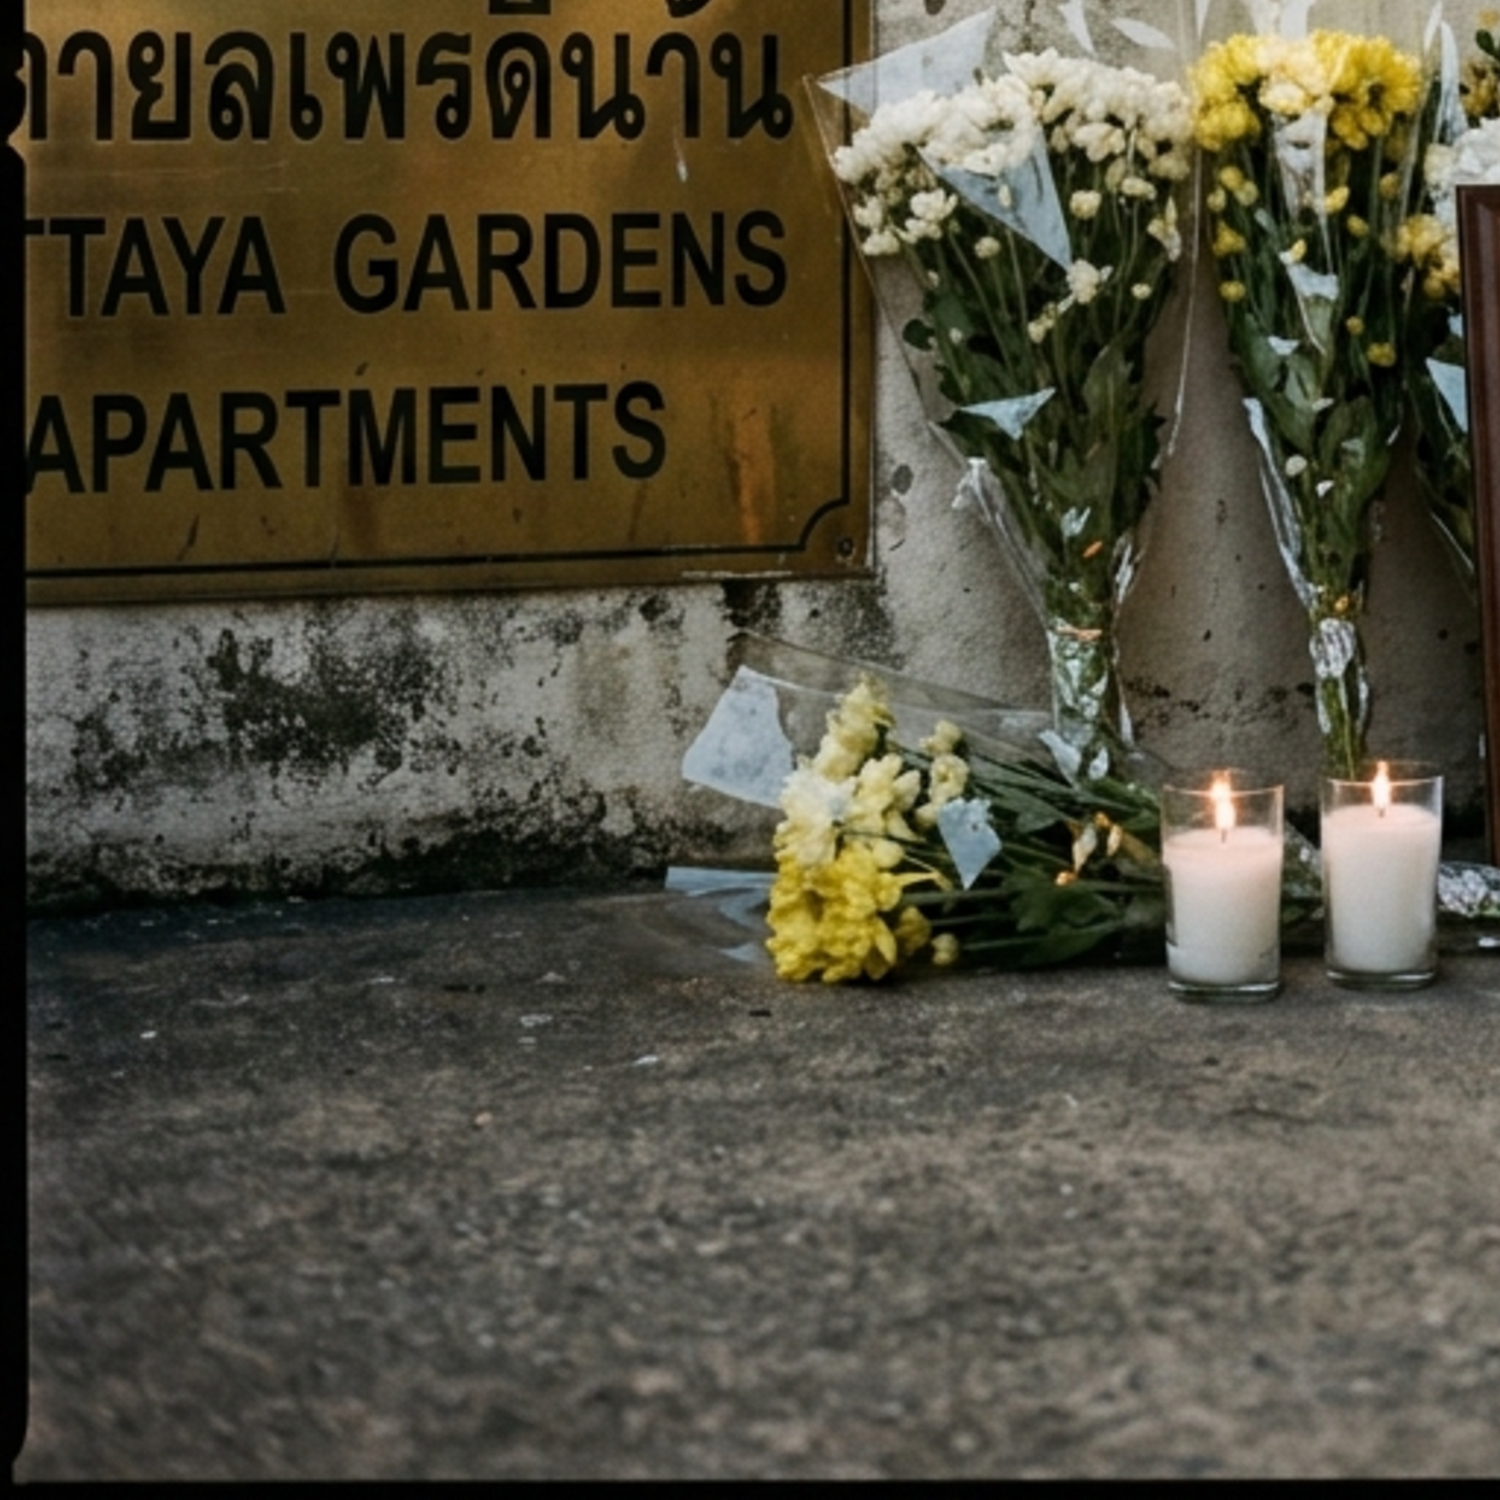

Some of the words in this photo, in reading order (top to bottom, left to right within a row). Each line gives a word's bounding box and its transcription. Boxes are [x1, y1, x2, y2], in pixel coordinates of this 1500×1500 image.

[25, 216, 287, 317] TAYA
[333, 210, 787, 313] GARDENS
[26, 381, 667, 494] APARTMENTS
